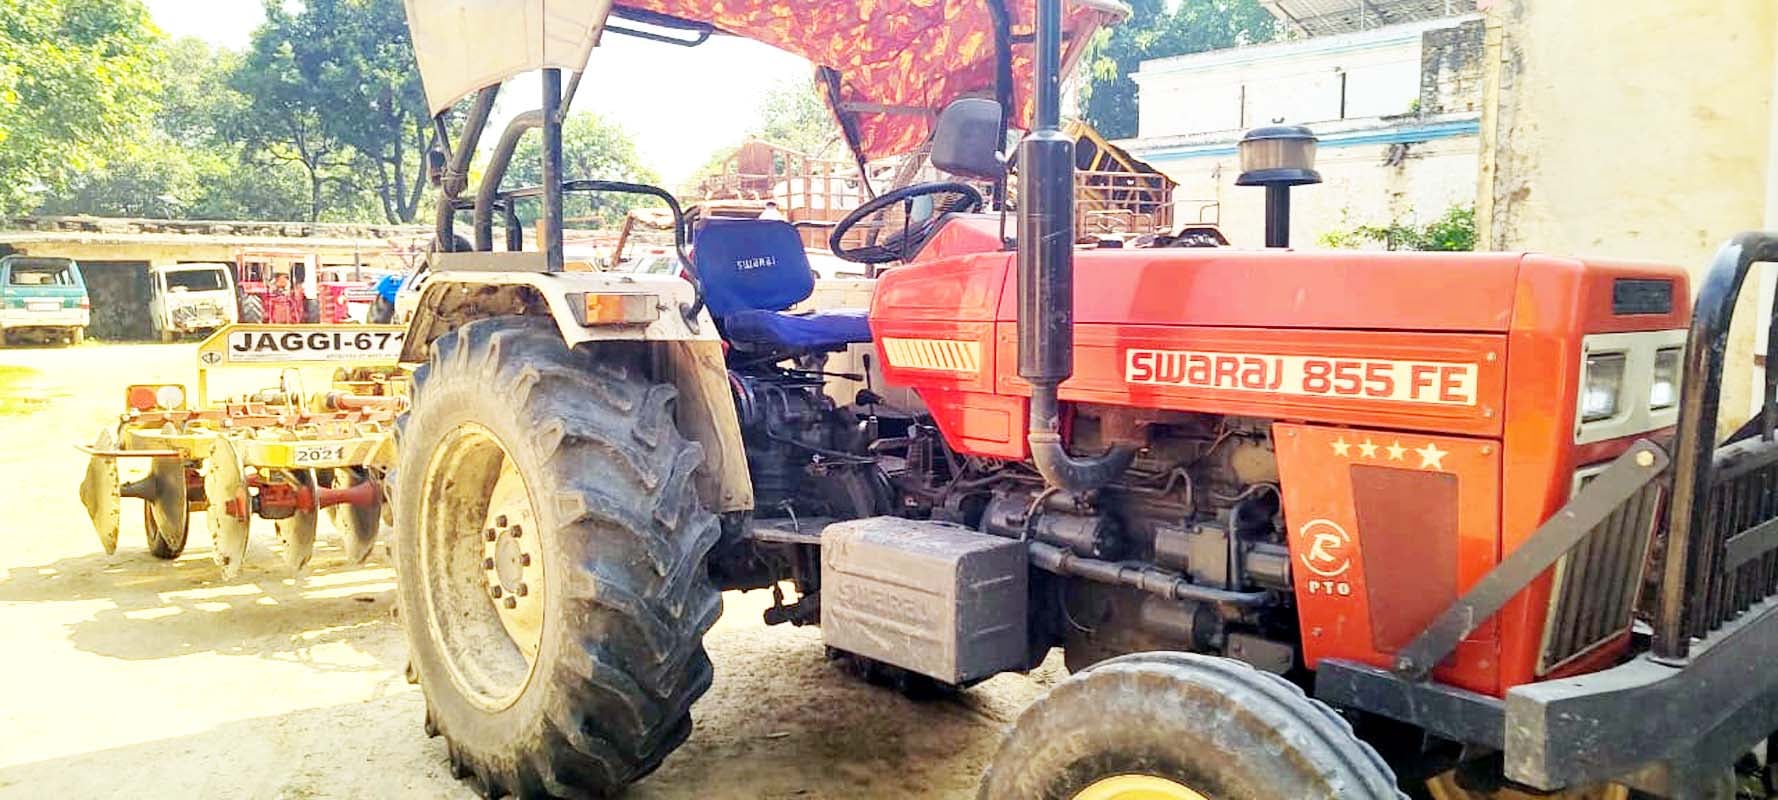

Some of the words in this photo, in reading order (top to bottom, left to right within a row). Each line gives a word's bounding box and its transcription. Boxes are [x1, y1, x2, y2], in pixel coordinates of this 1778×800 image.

[1302, 359, 1395, 398] 855
[1410, 364, 1468, 402] FE
[297, 446, 344, 461] 2021
[1310, 533, 1342, 562] R
[1307, 580, 1350, 595] PTO
